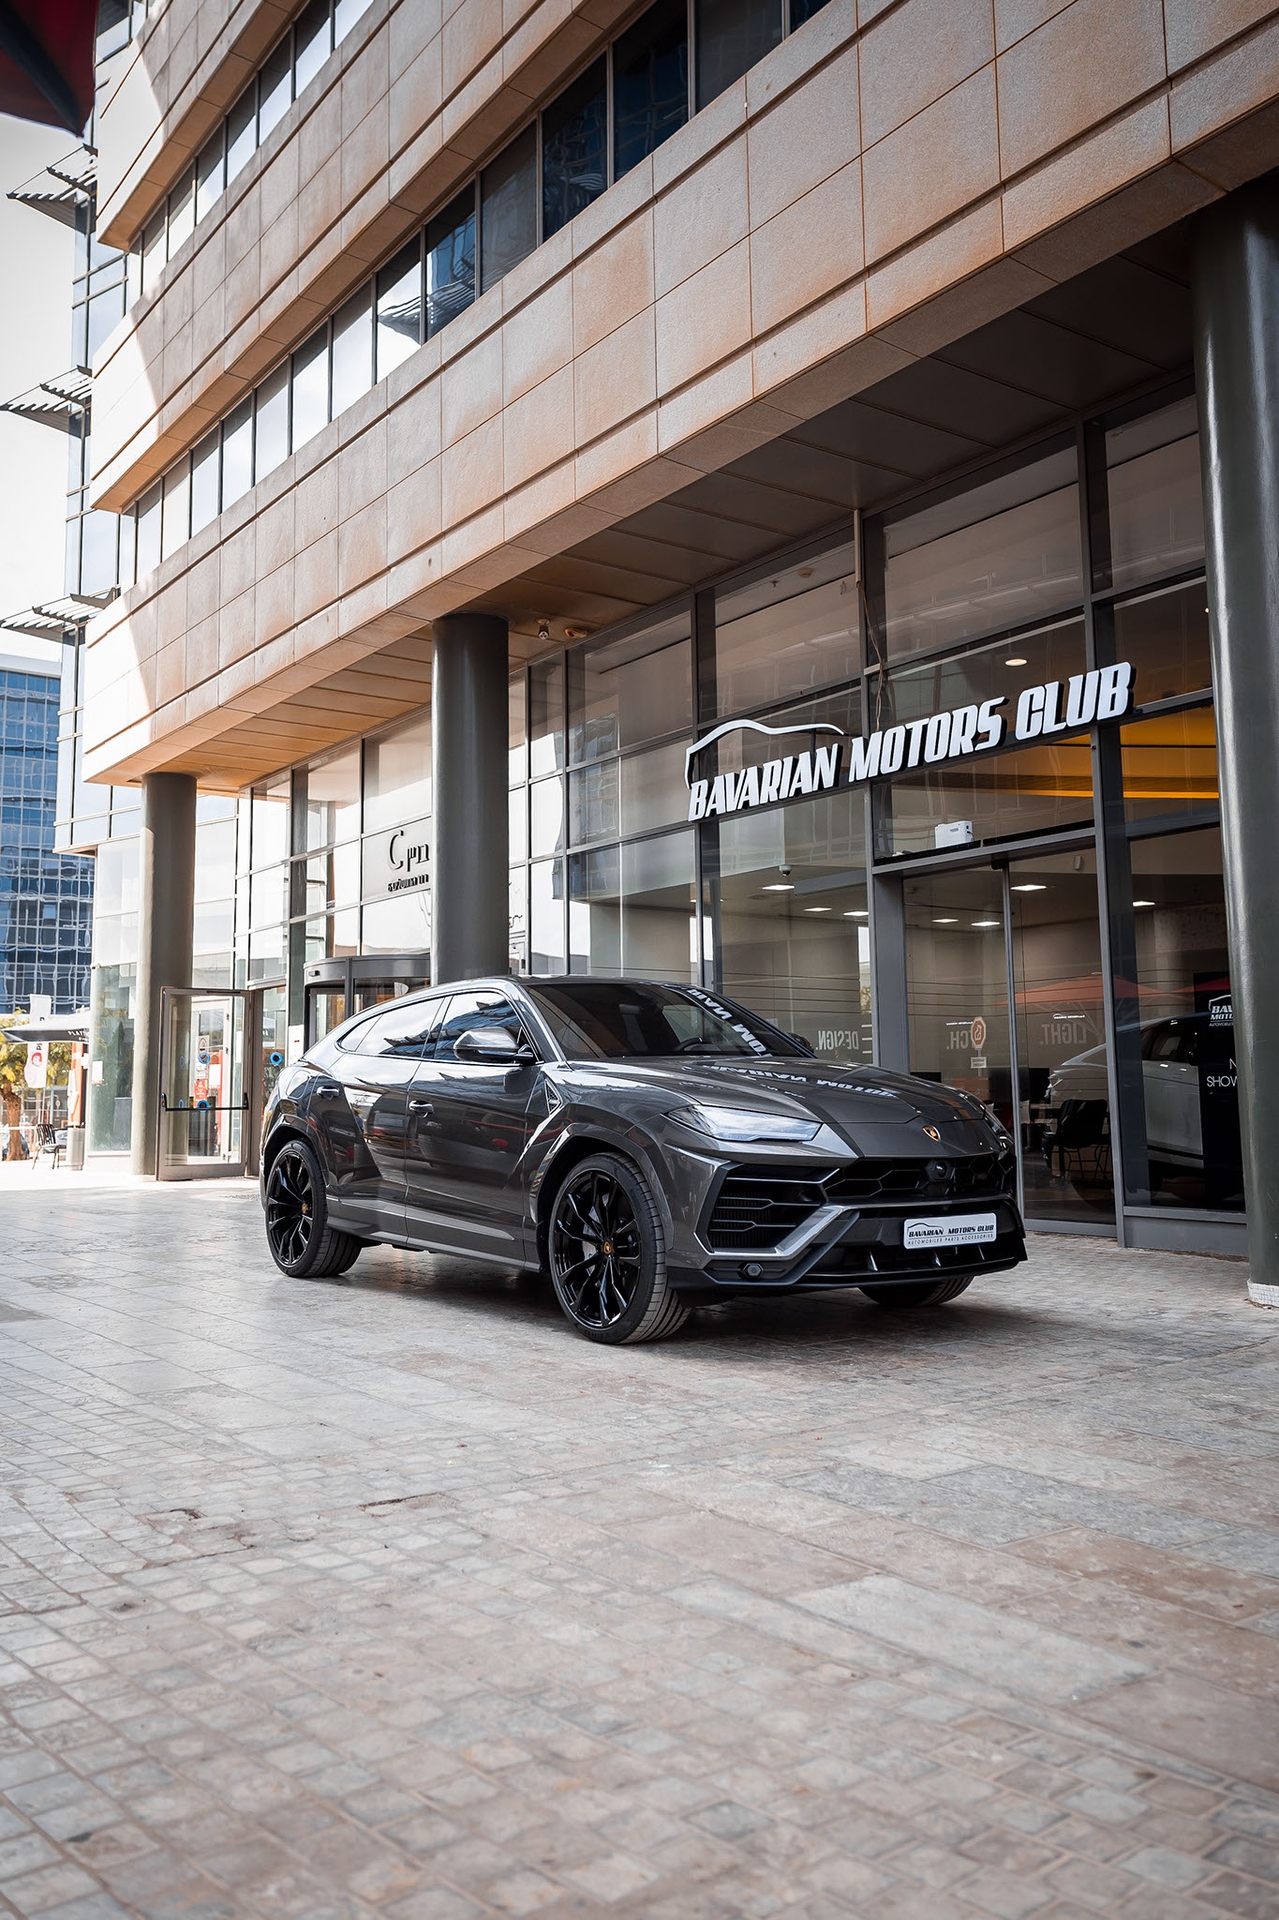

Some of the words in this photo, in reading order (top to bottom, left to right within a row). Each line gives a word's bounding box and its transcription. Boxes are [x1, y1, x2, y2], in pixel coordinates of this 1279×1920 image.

[688, 742, 841, 821] BAVARIAN
[849, 696, 1007, 782] MOTORS
[1015, 662, 1133, 740] CLUB
[908, 1229, 944, 1238] BAVARIAN
[948, 1226, 976, 1235] MOTORS
[977, 1224, 994, 1232] CLUB
